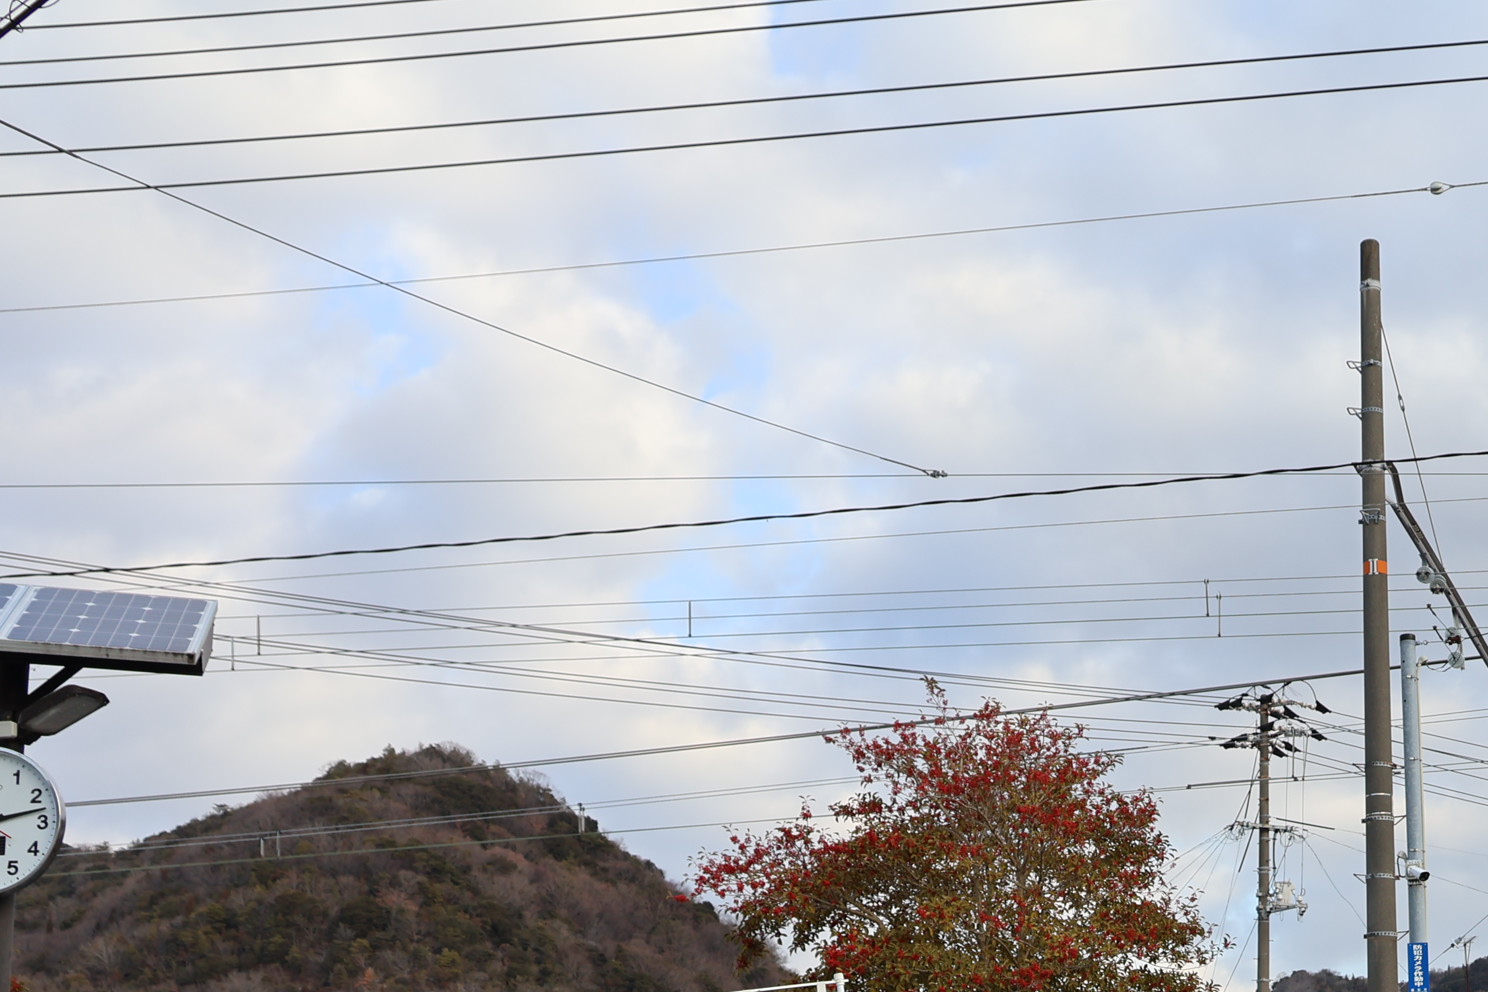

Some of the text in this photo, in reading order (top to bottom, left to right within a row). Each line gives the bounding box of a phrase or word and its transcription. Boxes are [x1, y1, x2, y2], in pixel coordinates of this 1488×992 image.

[13, 770, 20, 785] 1
[30, 788, 42, 804] 2
[37, 815, 48, 830] 3
[27, 841, 39, 856] 4
[7, 861, 19, 875] 5
[1413, 944, 1424, 987] 防犯カメラ作動中
